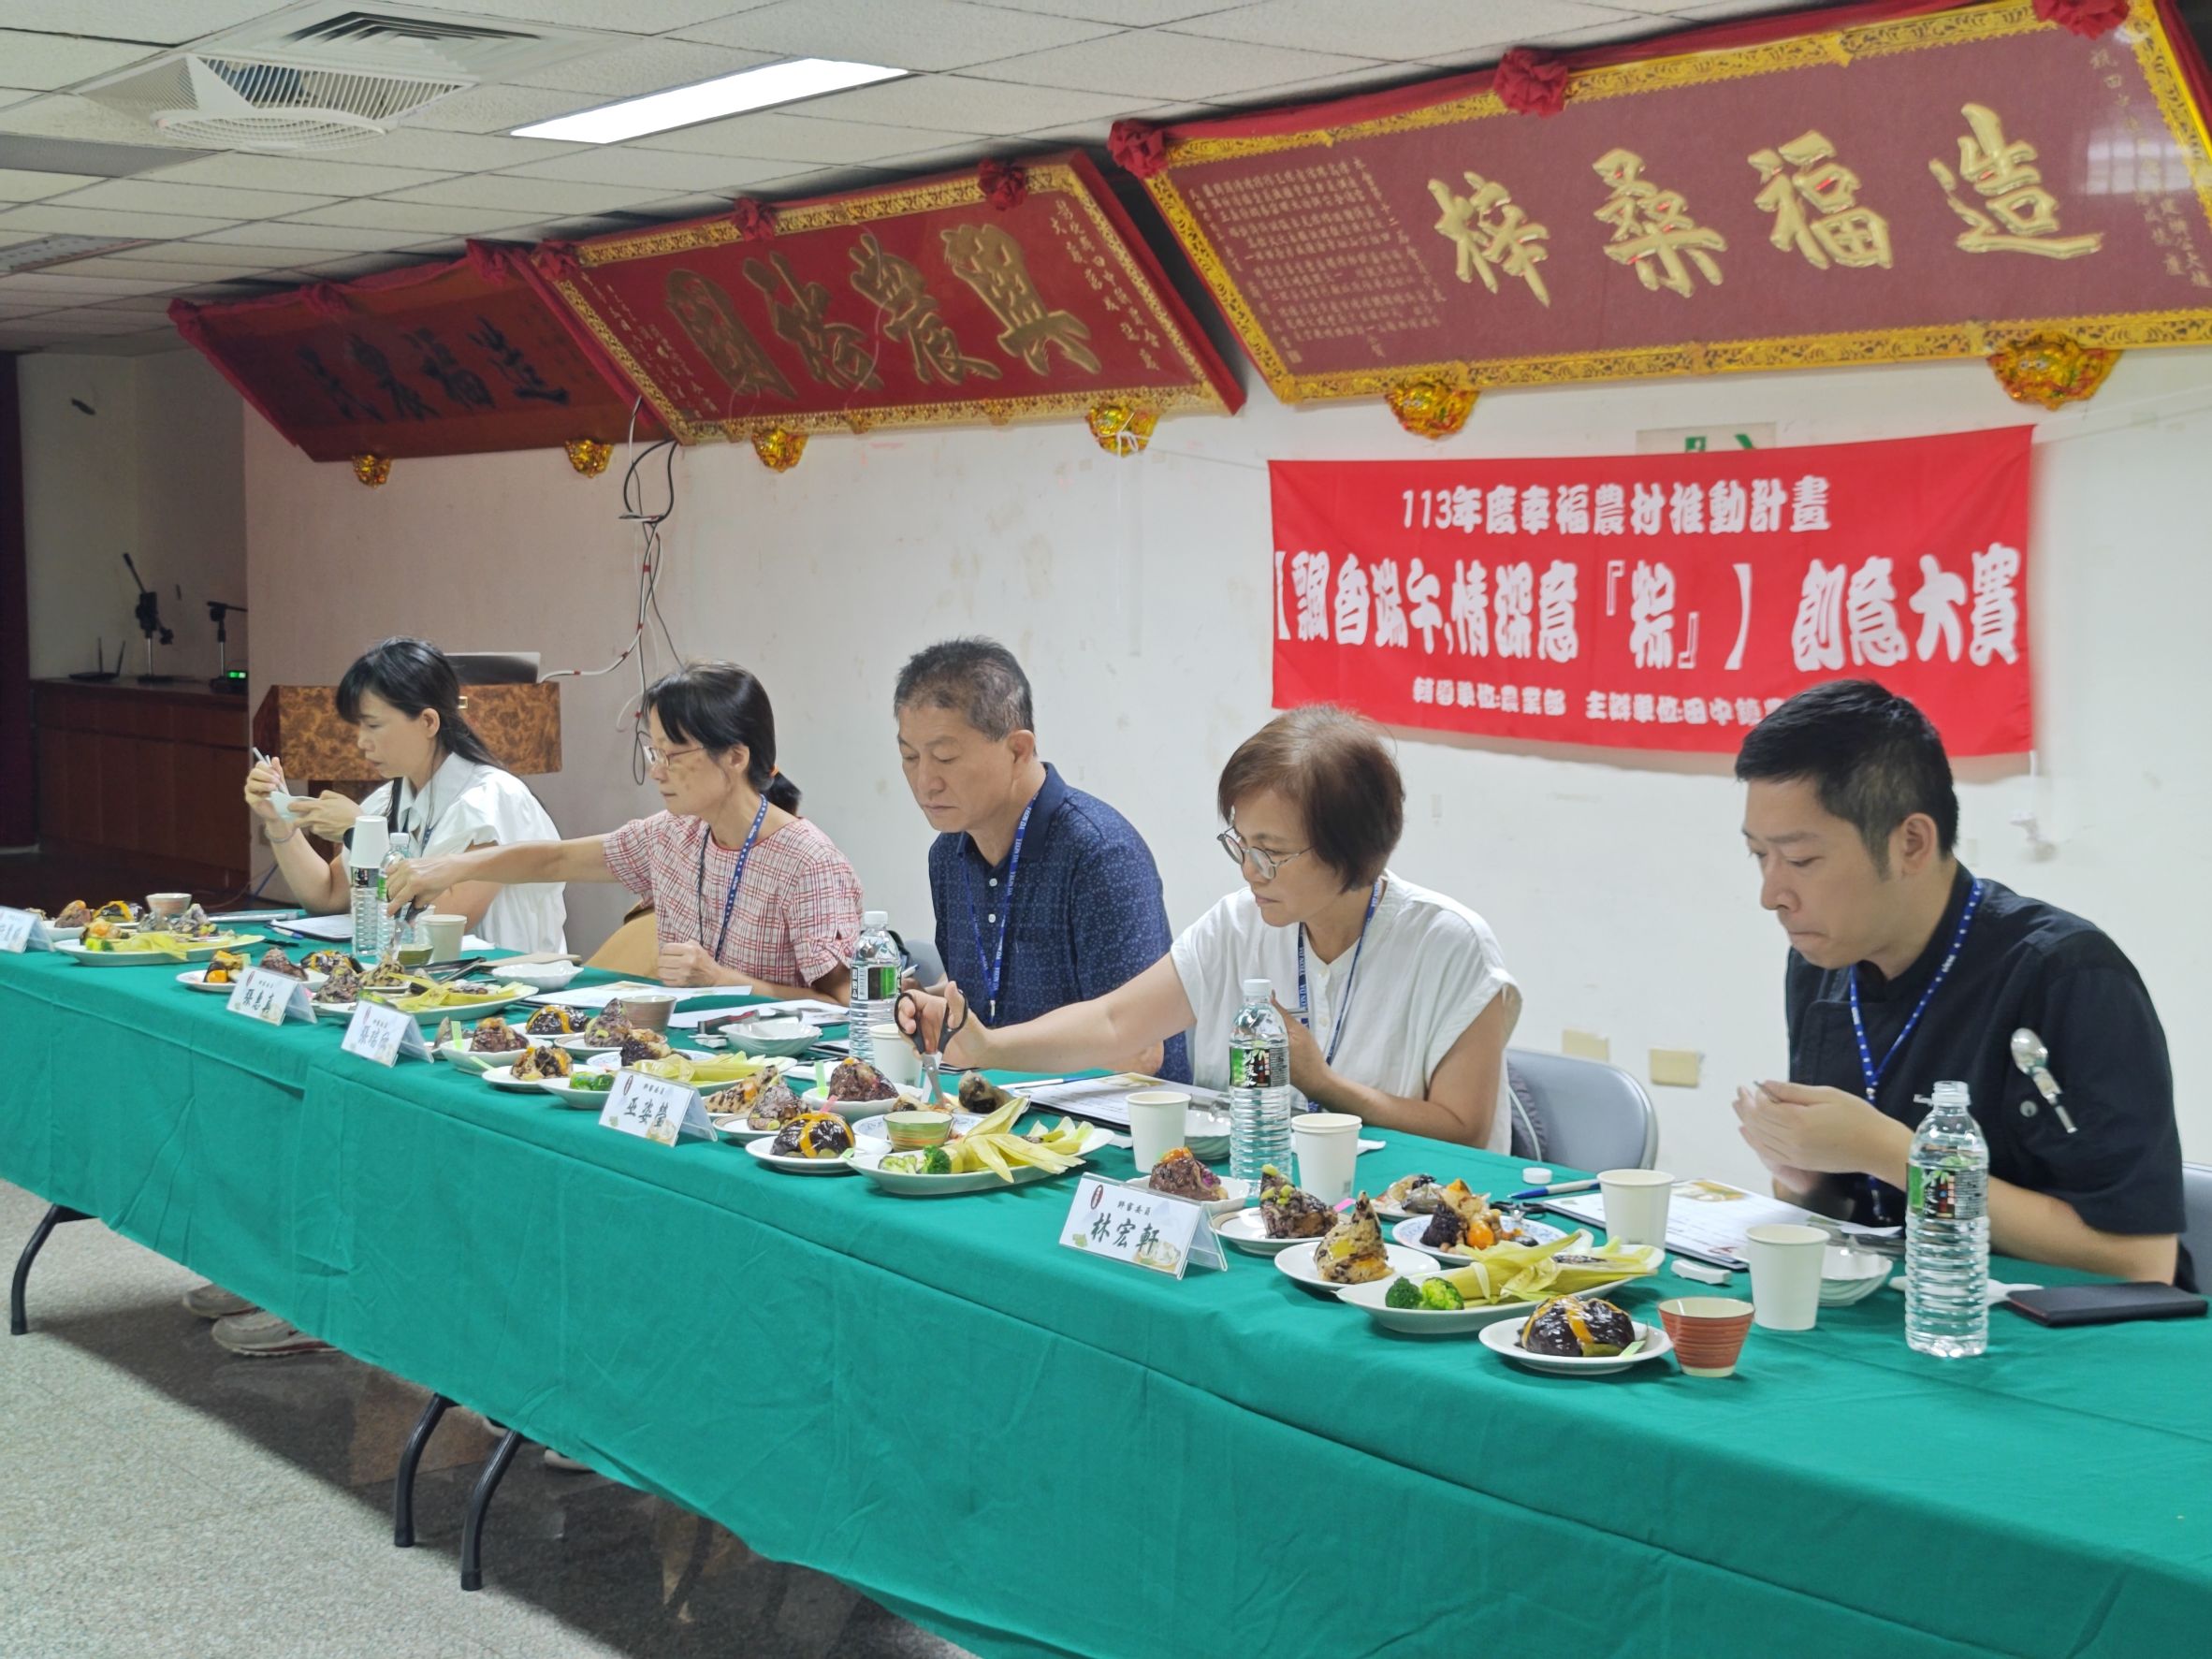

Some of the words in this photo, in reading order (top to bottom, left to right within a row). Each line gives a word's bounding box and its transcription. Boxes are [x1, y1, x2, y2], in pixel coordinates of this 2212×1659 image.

[1403, 474, 1831, 536] 113年度幸福農村推動計畫
[1091, 1213, 1159, 1255] 林宏軒
